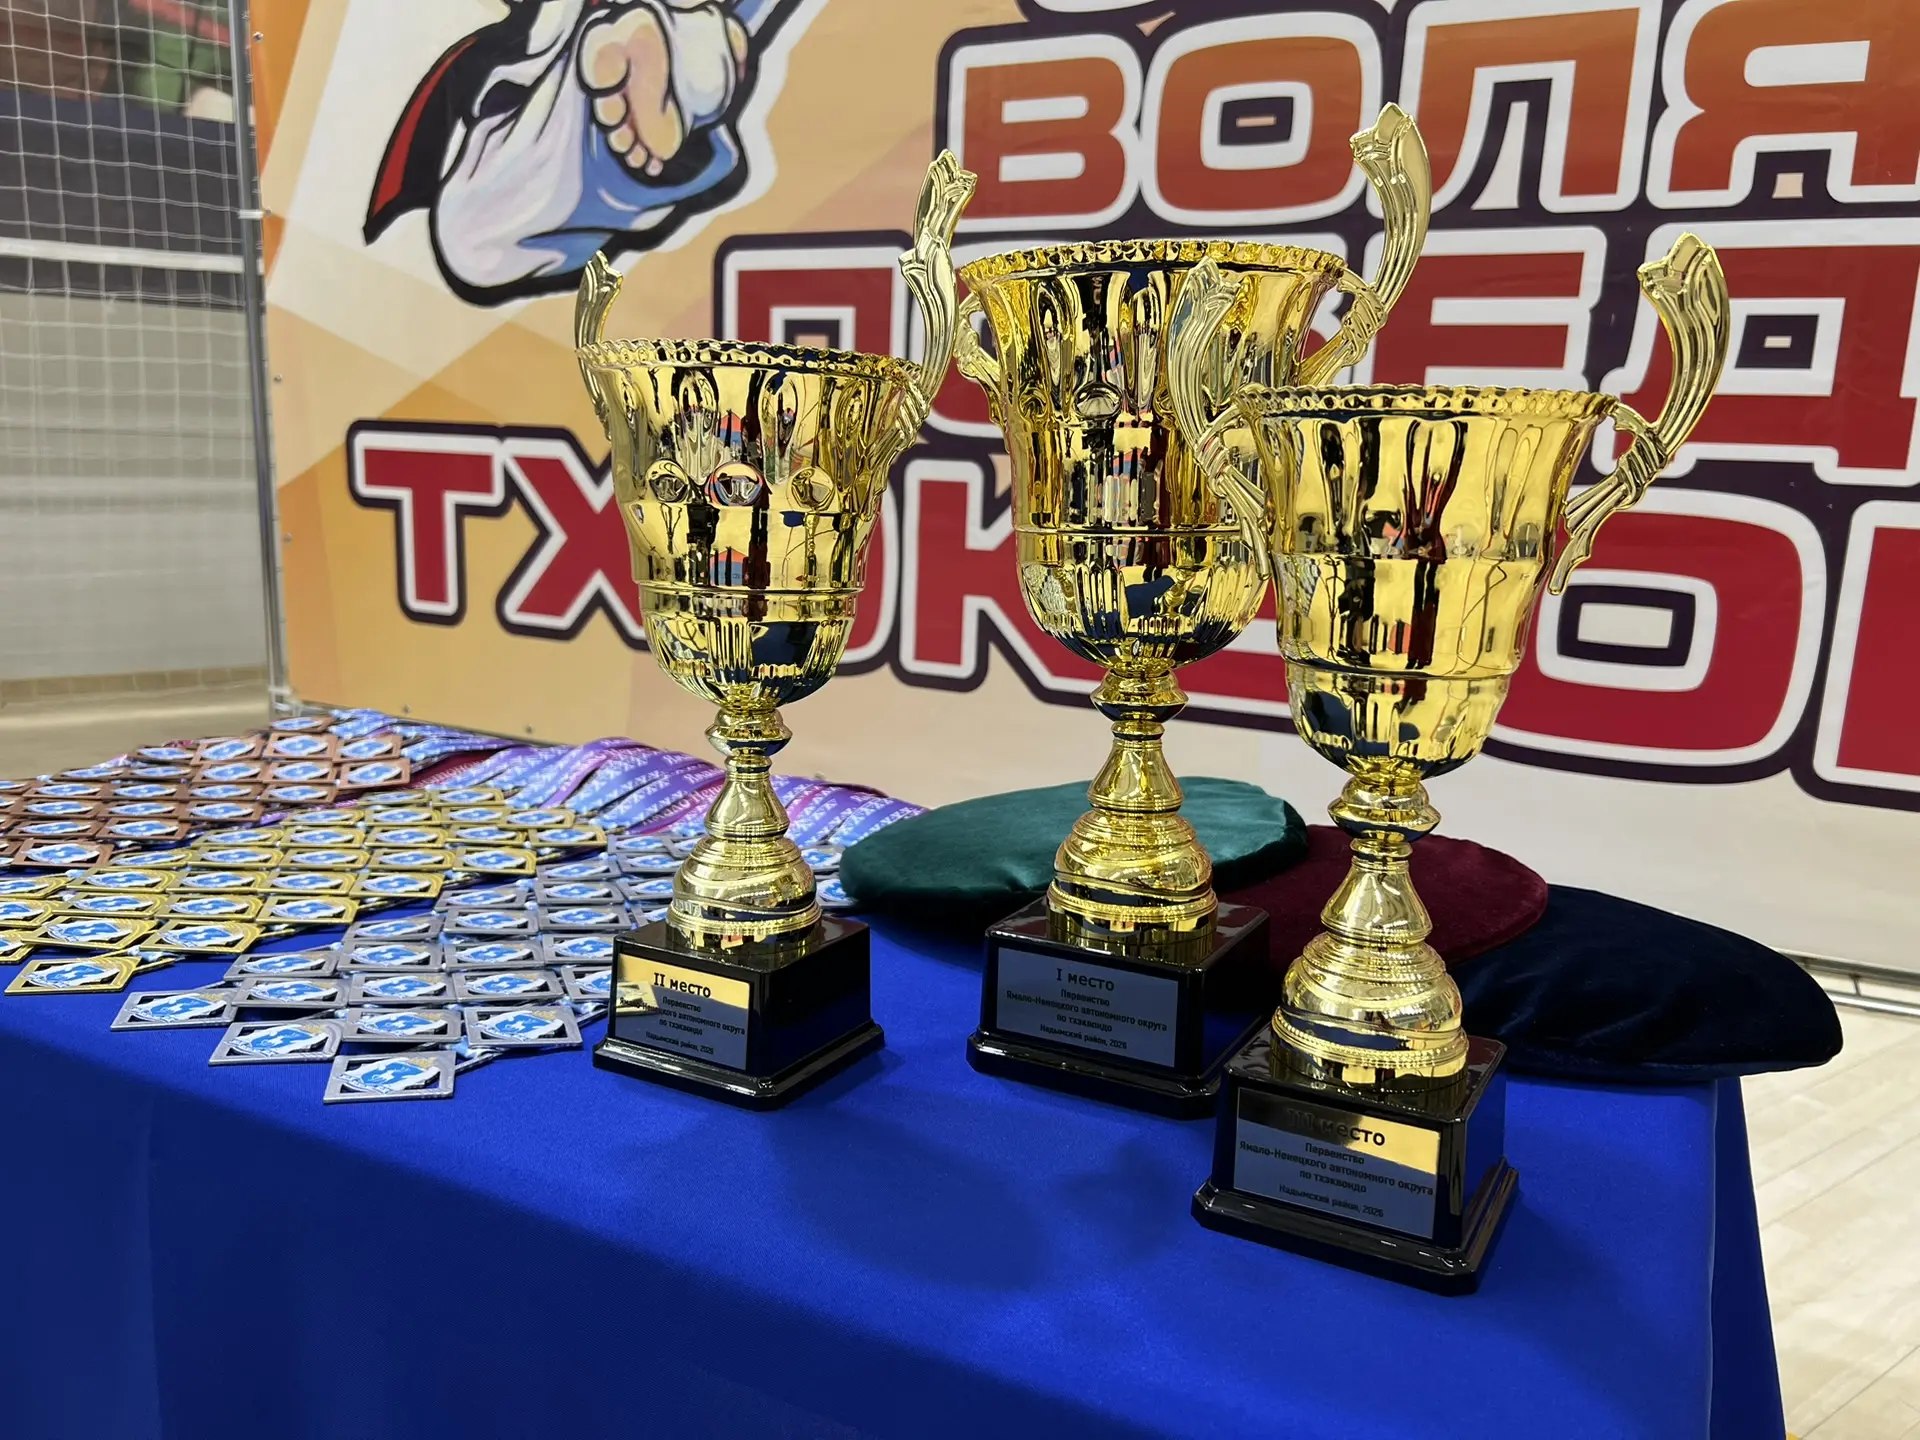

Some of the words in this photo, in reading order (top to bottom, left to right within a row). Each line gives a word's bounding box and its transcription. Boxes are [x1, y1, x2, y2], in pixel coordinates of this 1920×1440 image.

[952, 0, 1920, 224] ВОЛЯ
[653, 972, 666, 987] II
[670, 978, 712, 998] место
[1056, 967, 1064, 981] I
[1068, 972, 1115, 991] место
[1137, 1016, 1168, 1032] округа
[1397, 1177, 1434, 1196] округа
